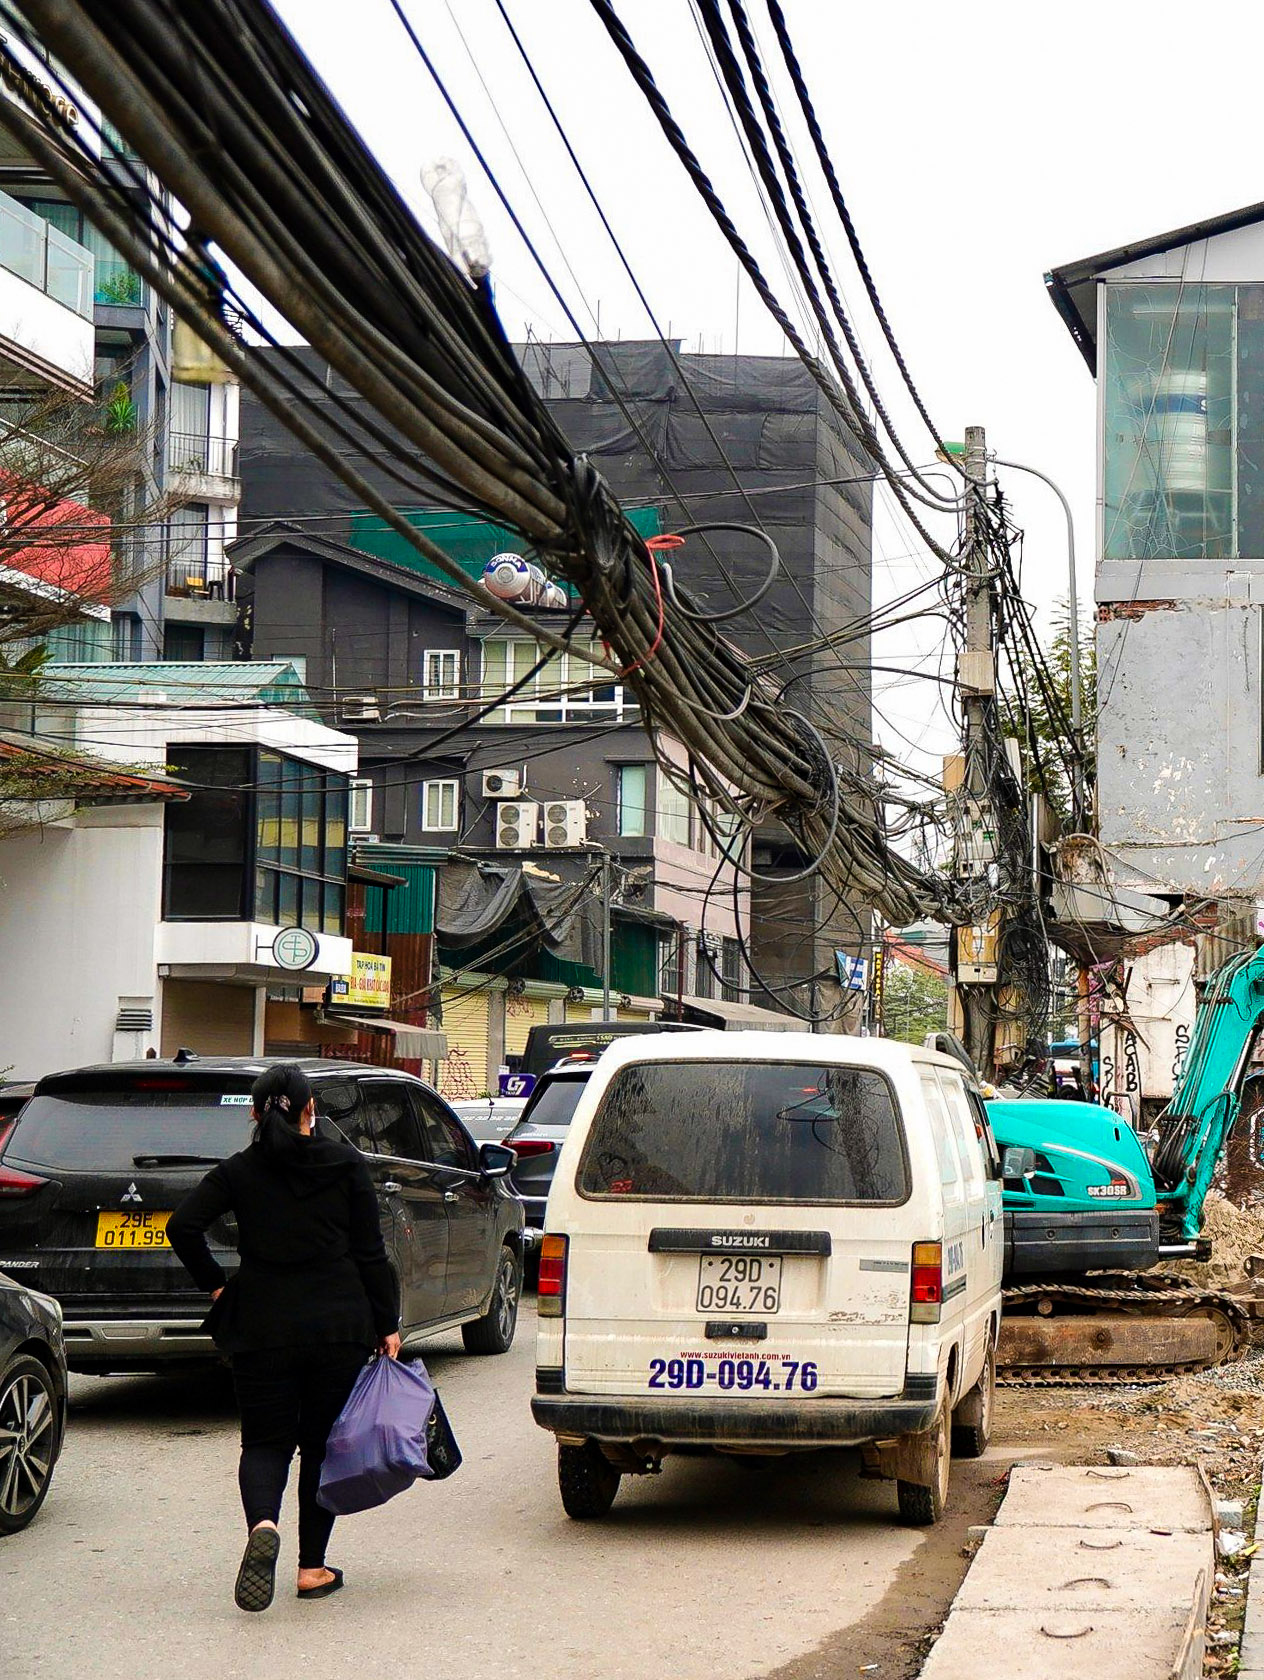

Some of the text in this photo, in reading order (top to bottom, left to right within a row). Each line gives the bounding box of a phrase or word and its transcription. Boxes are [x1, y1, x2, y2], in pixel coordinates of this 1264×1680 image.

[507, 1076, 526, 1095] G7
[1088, 1185, 1127, 1196] SK30SR
[121, 1212, 153, 1228] 29E
[104, 1230, 165, 1246] 011.99
[711, 1235, 770, 1247] SUZUKI
[719, 1257, 762, 1283] 29D
[700, 1284, 777, 1311] 094.76
[680, 1350, 791, 1361] www.suzukivietanh.com.vn
[648, 1358, 818, 1392] 29D-094.76
